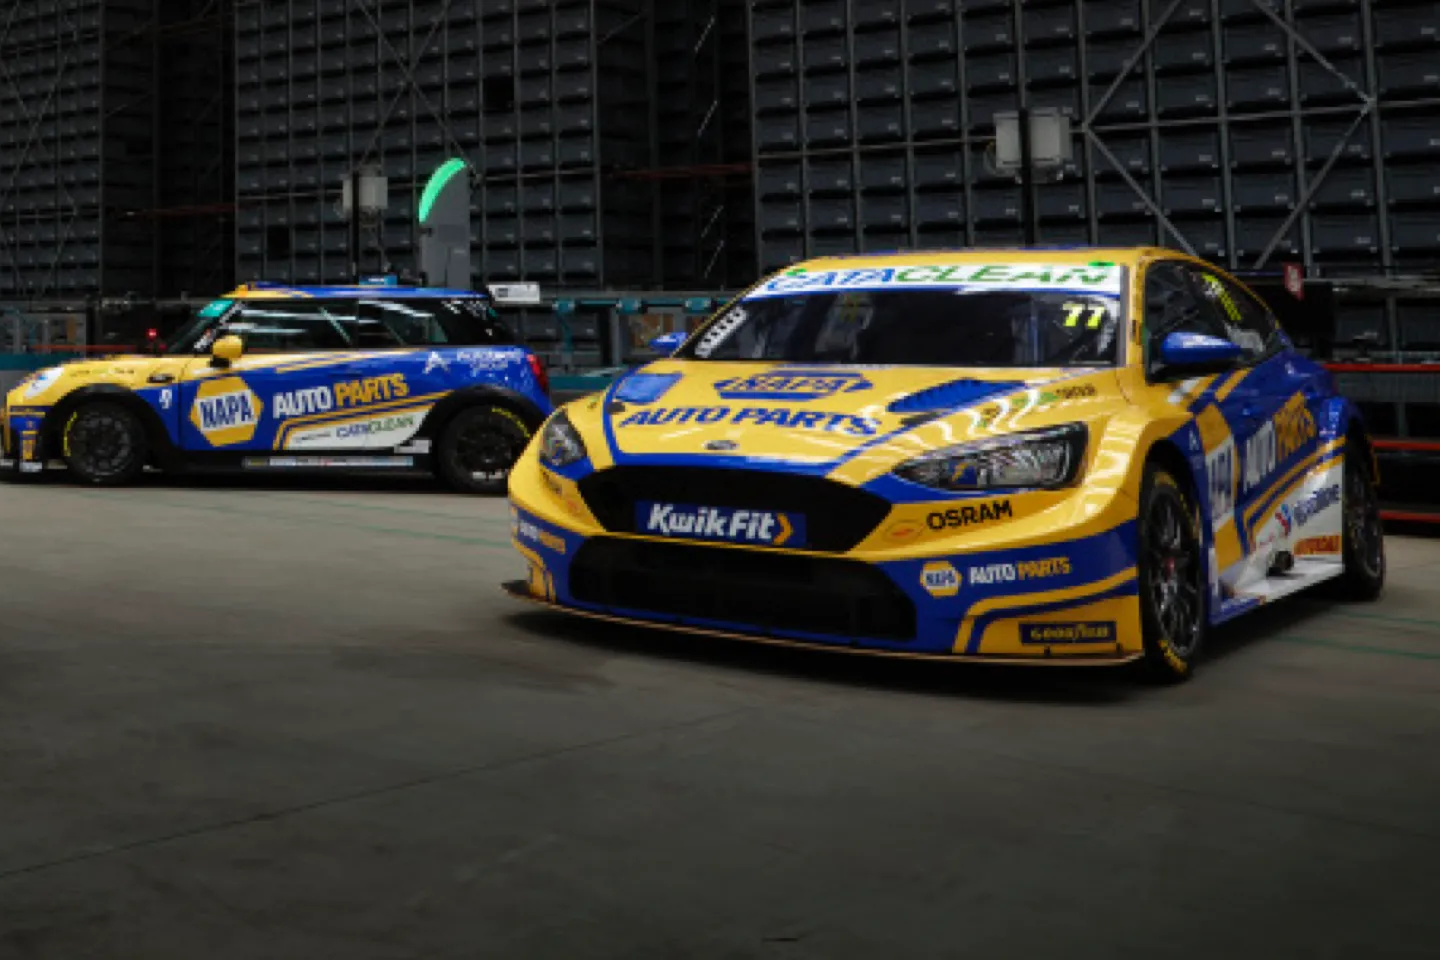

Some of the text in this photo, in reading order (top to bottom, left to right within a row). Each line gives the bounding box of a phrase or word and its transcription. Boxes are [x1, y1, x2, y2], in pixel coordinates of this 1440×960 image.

[1062, 303, 1105, 328] 77
[273, 373, 409, 419] AUTO PARTS
[200, 393, 254, 429] NAPA
[619, 407, 882, 436] AUTO PARTS
[926, 500, 1013, 530] OSRAM
[969, 557, 1071, 586] AUTO PARTS
